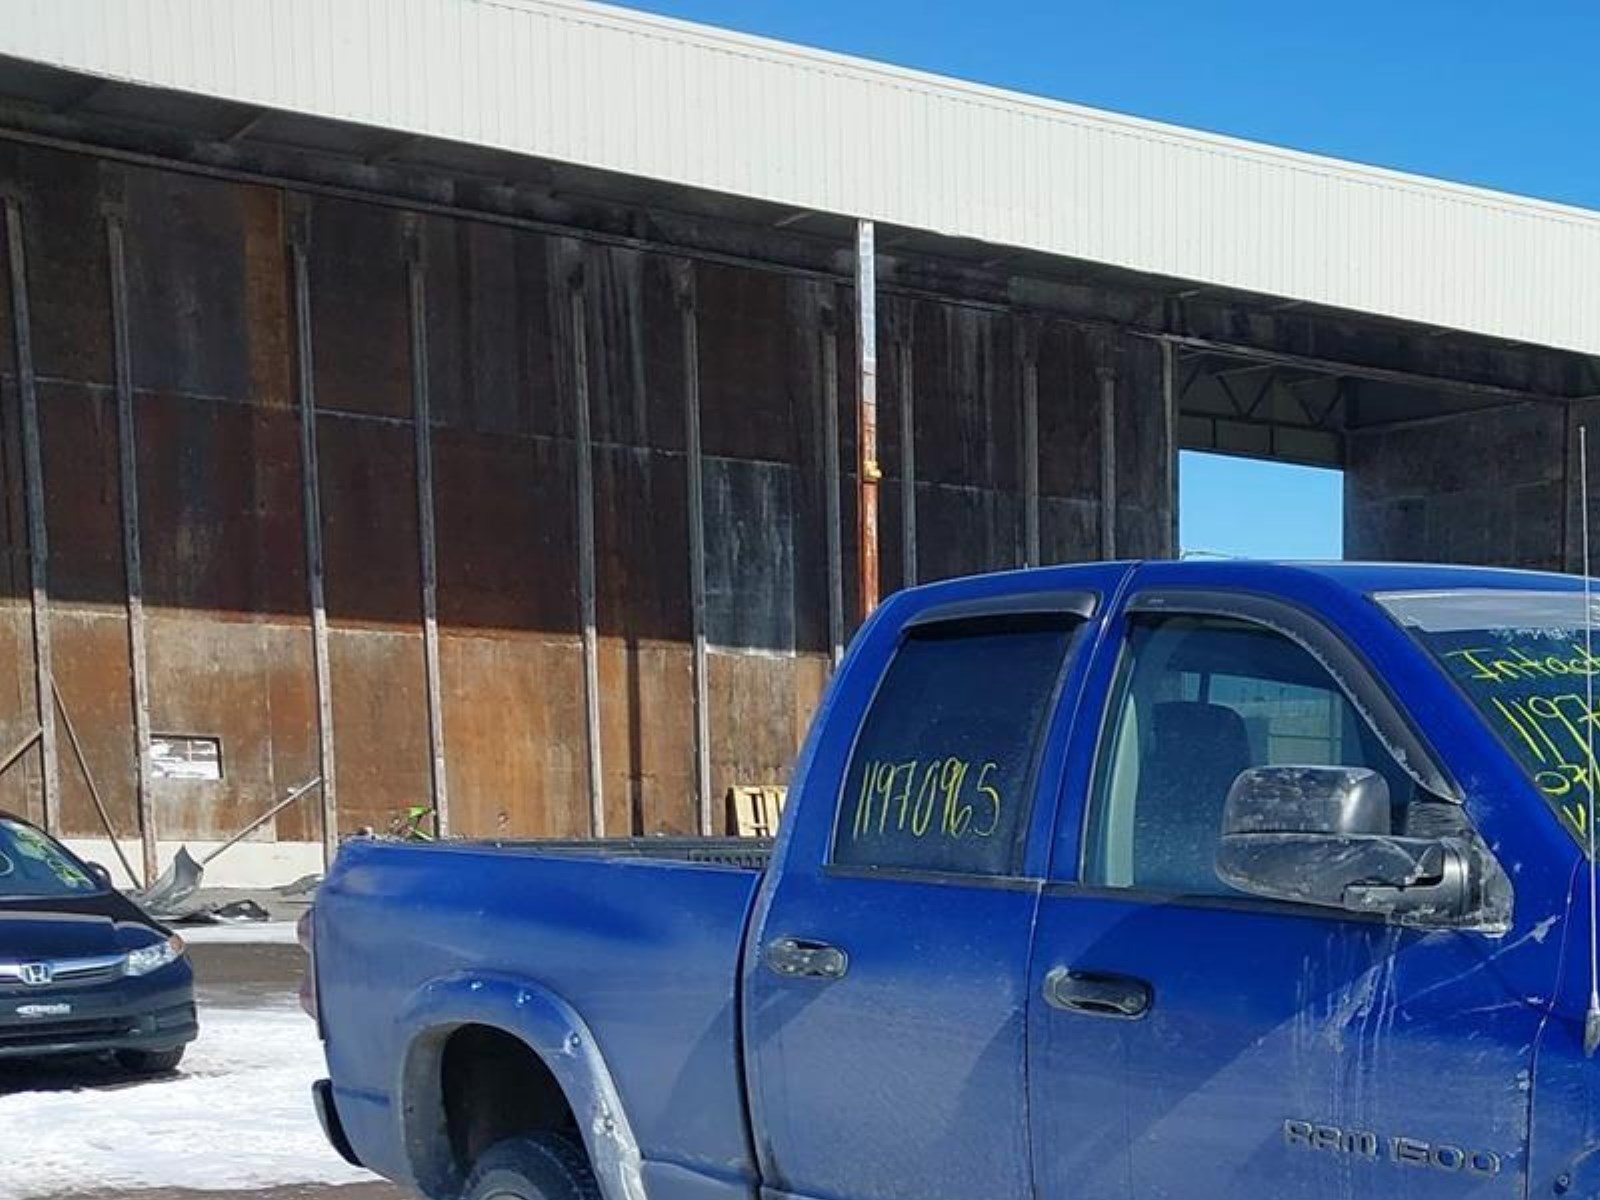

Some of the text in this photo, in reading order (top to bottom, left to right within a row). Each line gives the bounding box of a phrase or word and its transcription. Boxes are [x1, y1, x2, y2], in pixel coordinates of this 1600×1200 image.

[853, 757, 1000, 840] 11970965
[1283, 1118, 1501, 1177] RAM 1500
